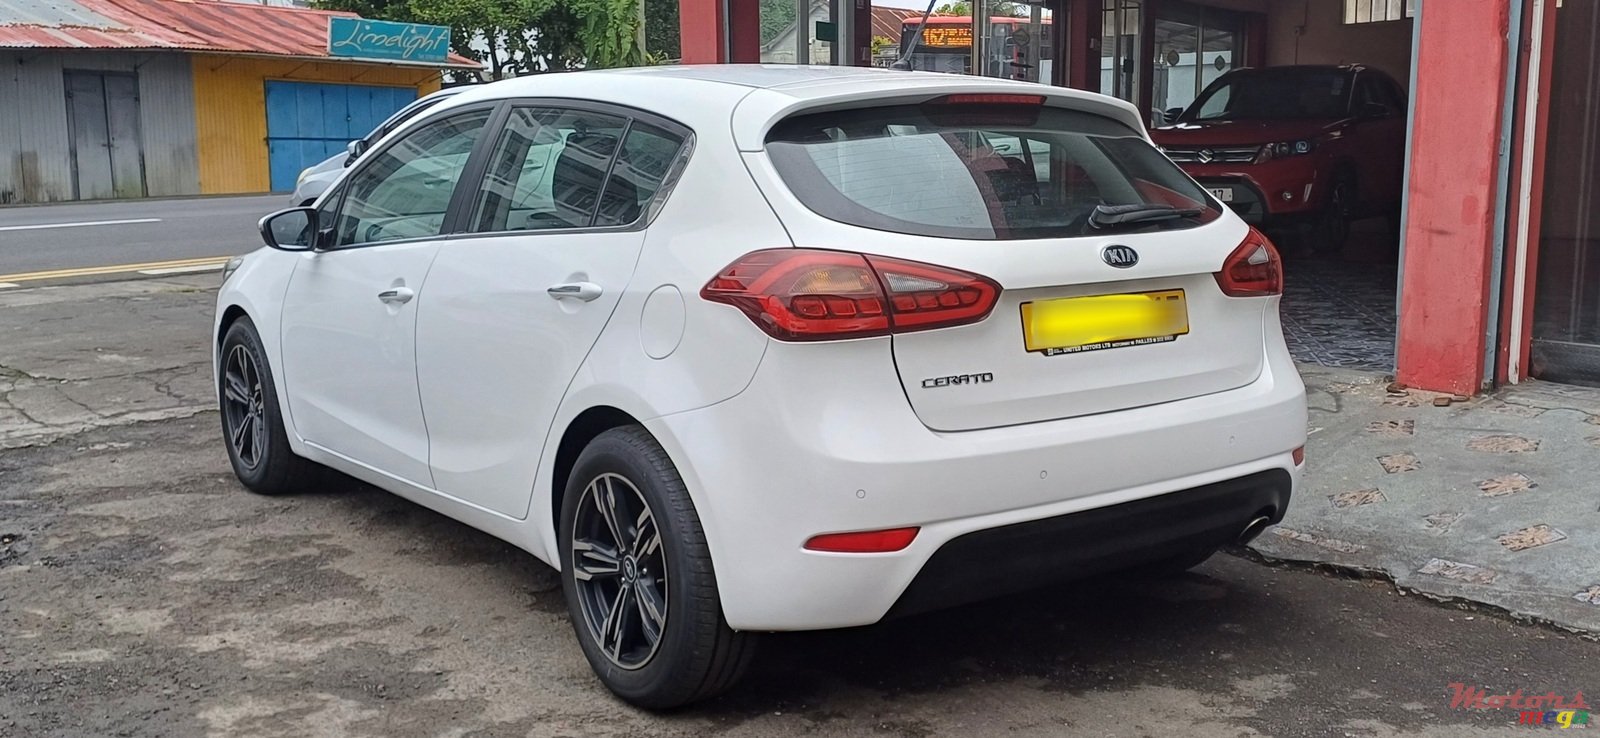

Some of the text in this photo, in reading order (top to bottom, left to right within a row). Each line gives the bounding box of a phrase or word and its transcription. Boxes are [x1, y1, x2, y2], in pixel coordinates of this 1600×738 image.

[333, 22, 447, 59] Limelight
[923, 28, 945, 45] 162
[1108, 248, 1137, 264] KIA
[1081, 343, 1102, 351] MOTORS
[921, 372, 993, 388] CERATO
